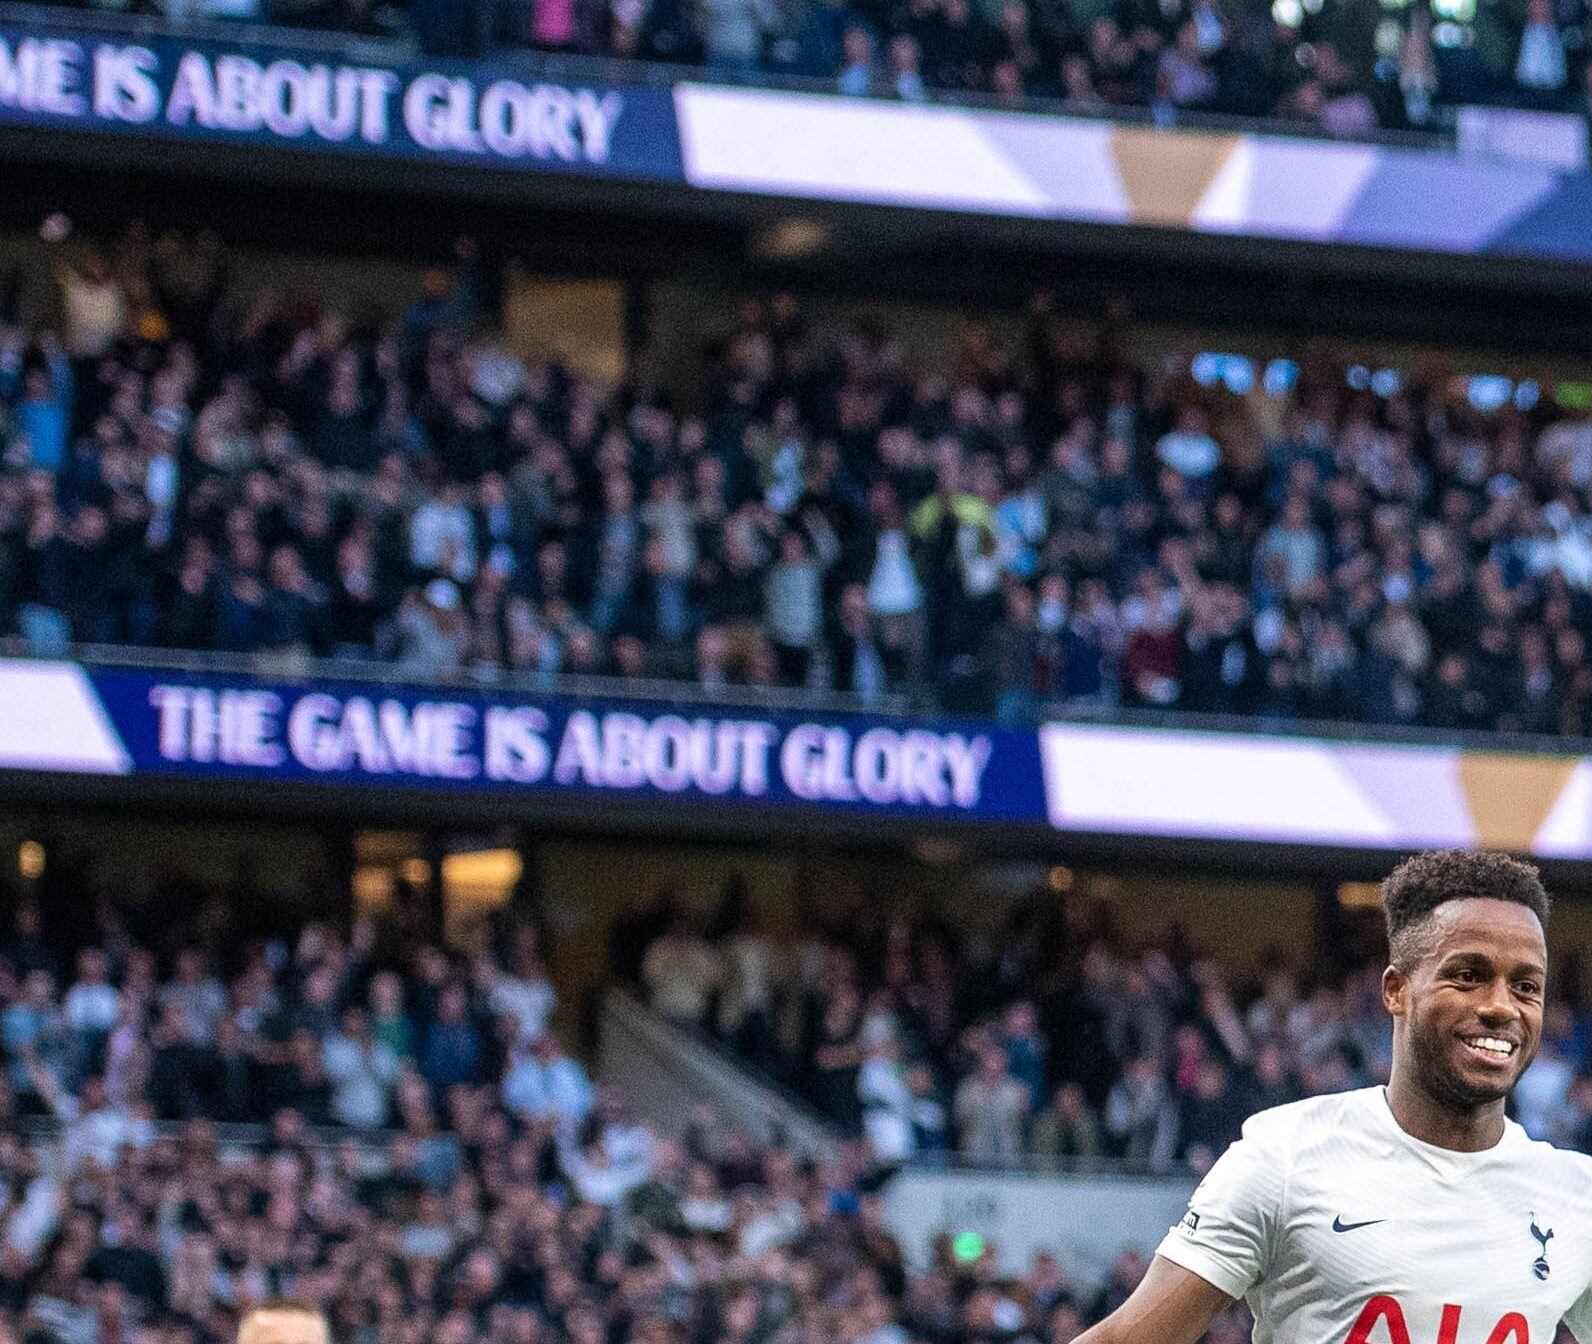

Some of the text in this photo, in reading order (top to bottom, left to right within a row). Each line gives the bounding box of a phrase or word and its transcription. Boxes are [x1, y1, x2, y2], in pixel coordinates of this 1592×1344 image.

[94, 44, 159, 123] IS
[166, 51, 400, 144] ABOUT
[404, 72, 624, 163] GLORY
[149, 684, 991, 809] THE GAME IS ABOUT GLORY
